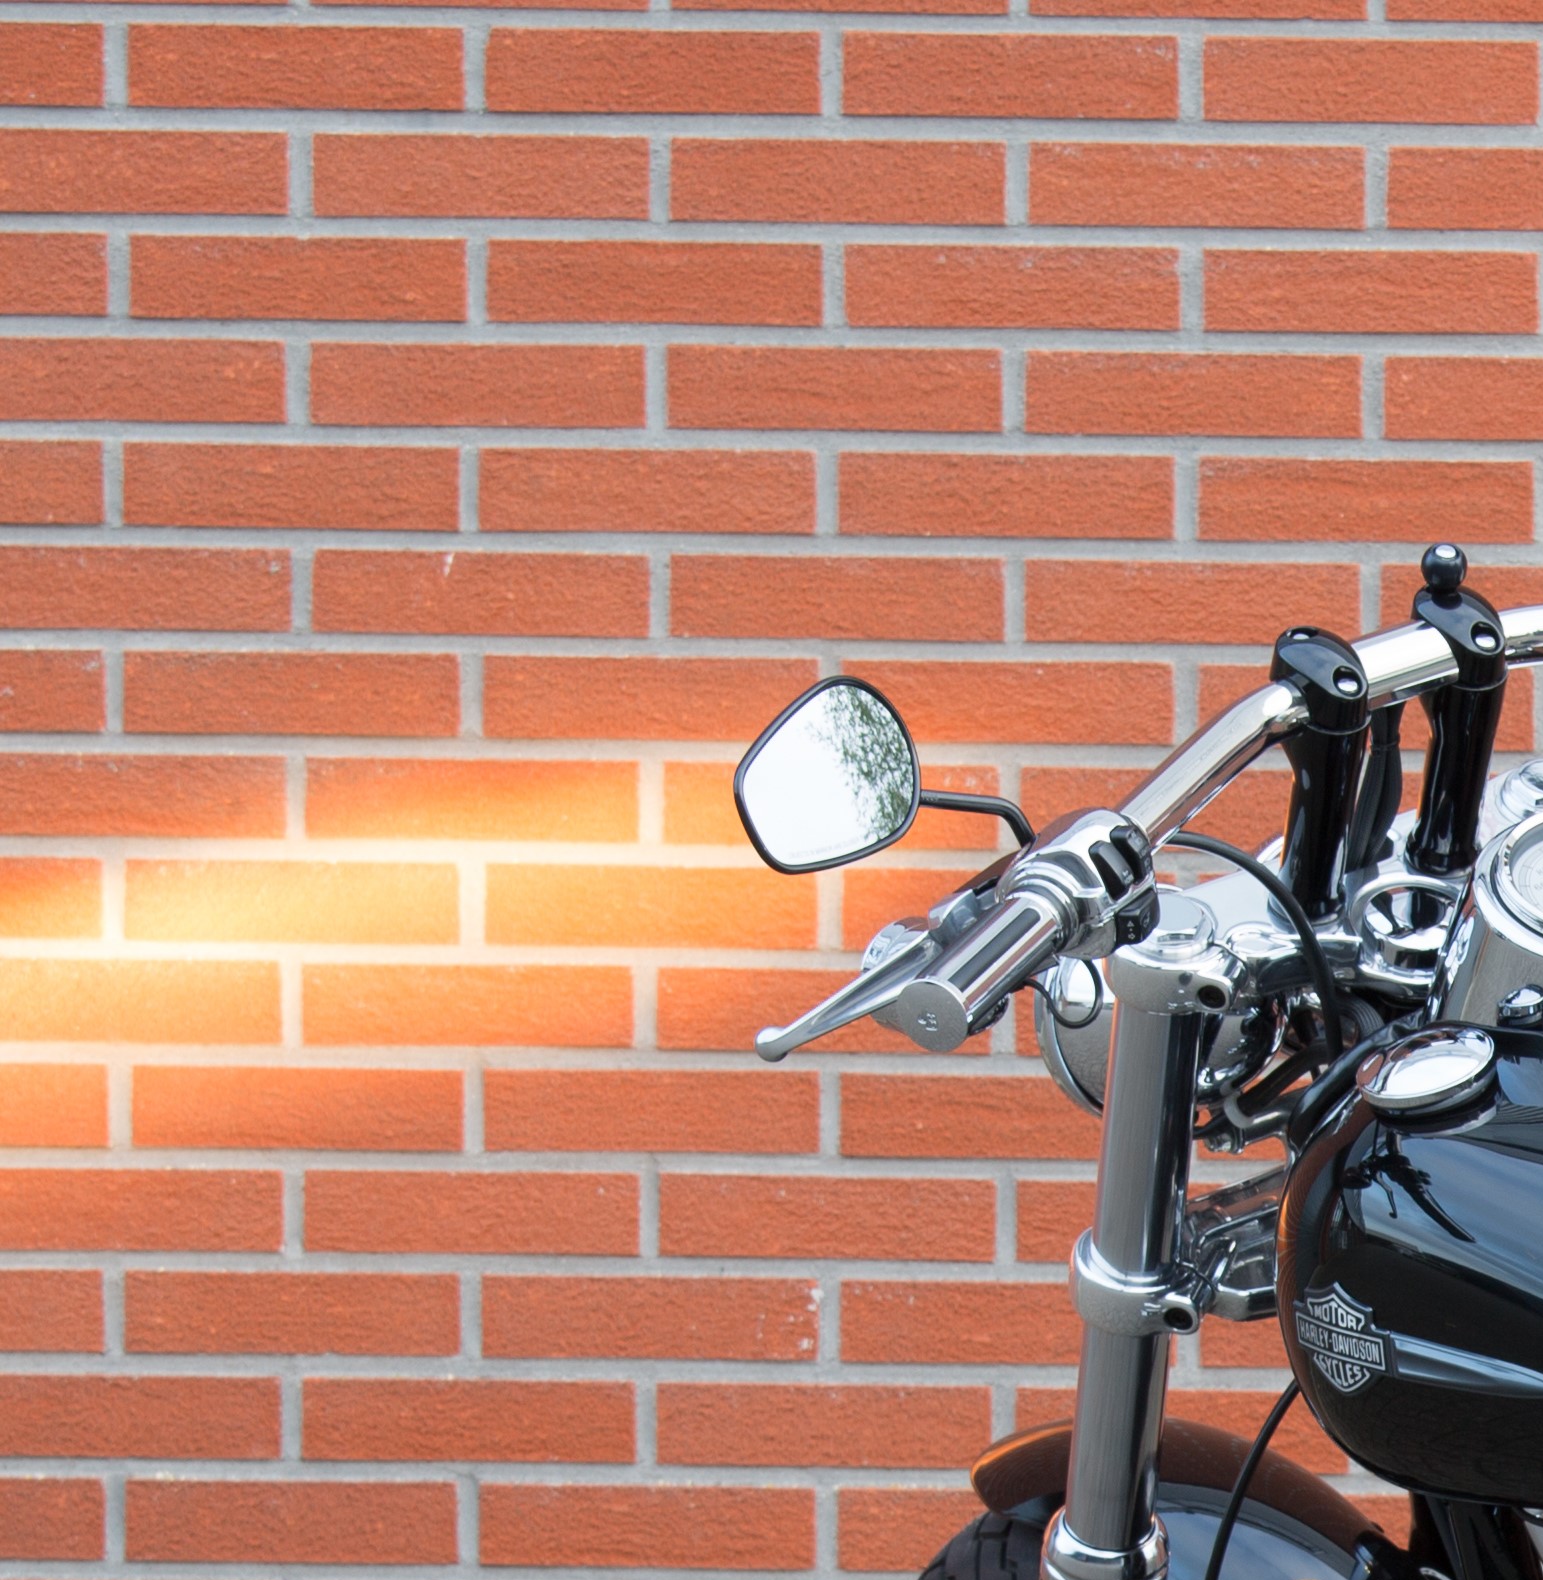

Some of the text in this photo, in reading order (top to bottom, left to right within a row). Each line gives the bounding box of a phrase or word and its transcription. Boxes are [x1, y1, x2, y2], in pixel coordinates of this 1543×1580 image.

[1313, 1300, 1357, 1331] MOTOR
[1299, 1319, 1380, 1364] HARLEY-DAVIDSON
[1318, 1354, 1361, 1387] CYCLES
